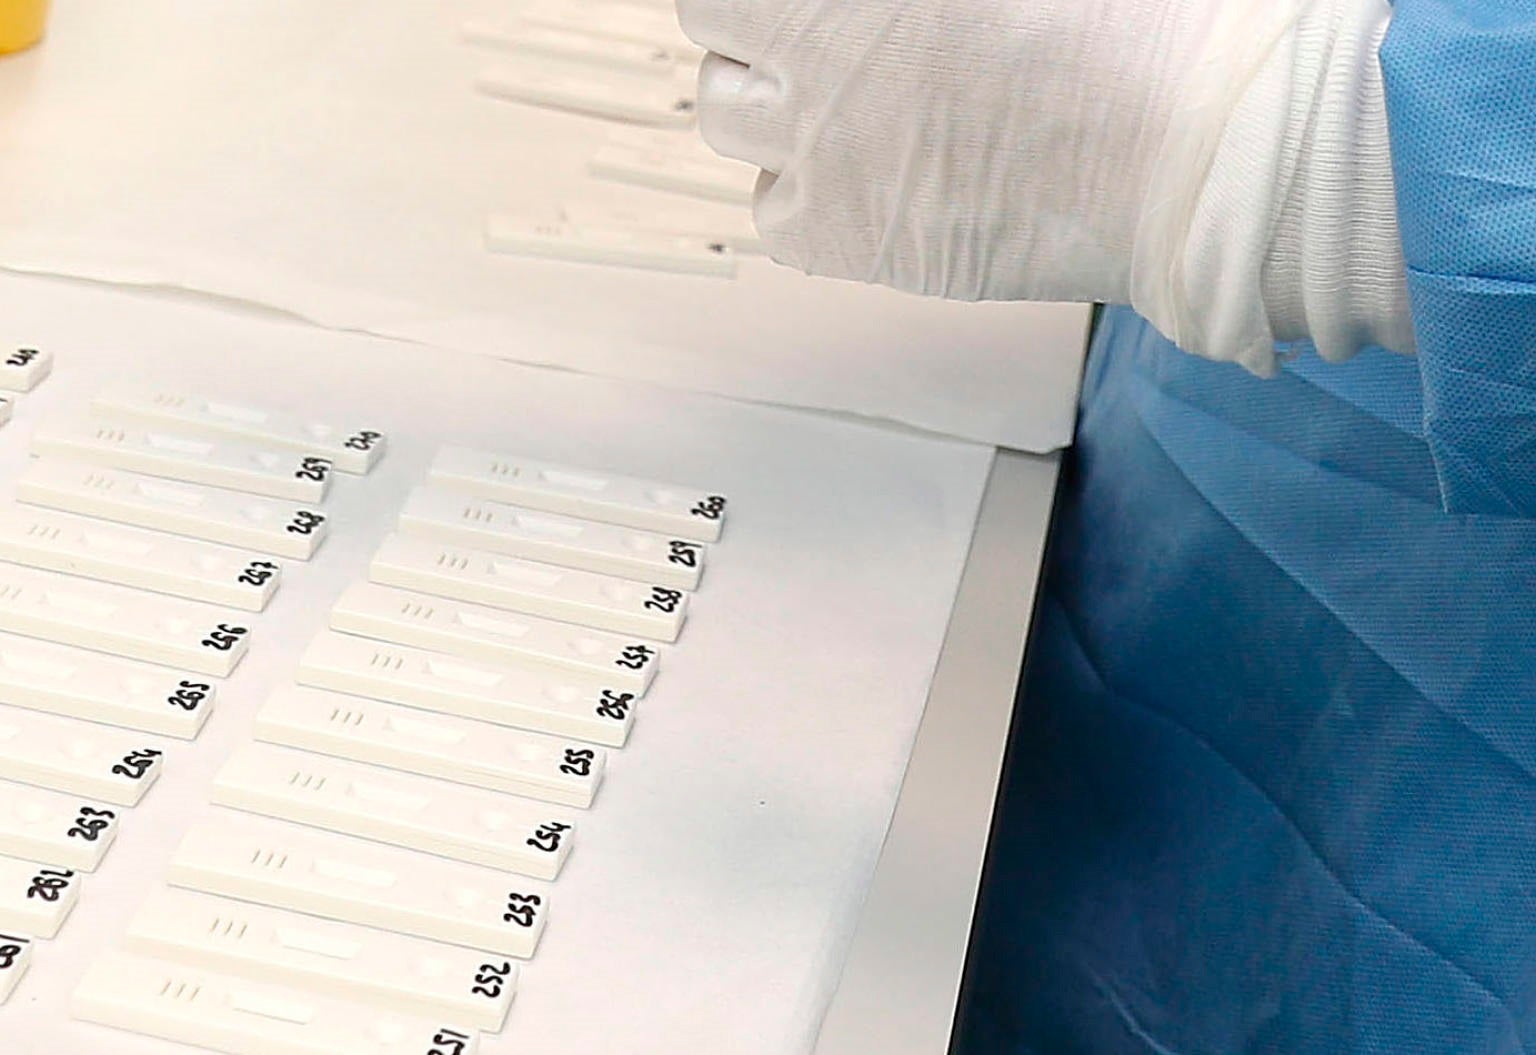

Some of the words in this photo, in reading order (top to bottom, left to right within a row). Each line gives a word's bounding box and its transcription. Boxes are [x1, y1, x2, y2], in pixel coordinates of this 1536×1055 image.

[558, 747, 596, 778] 255
[66, 805, 116, 843] 263
[525, 820, 573, 854] 254
[502, 891, 542, 929] 253
[470, 961, 512, 999] 252
